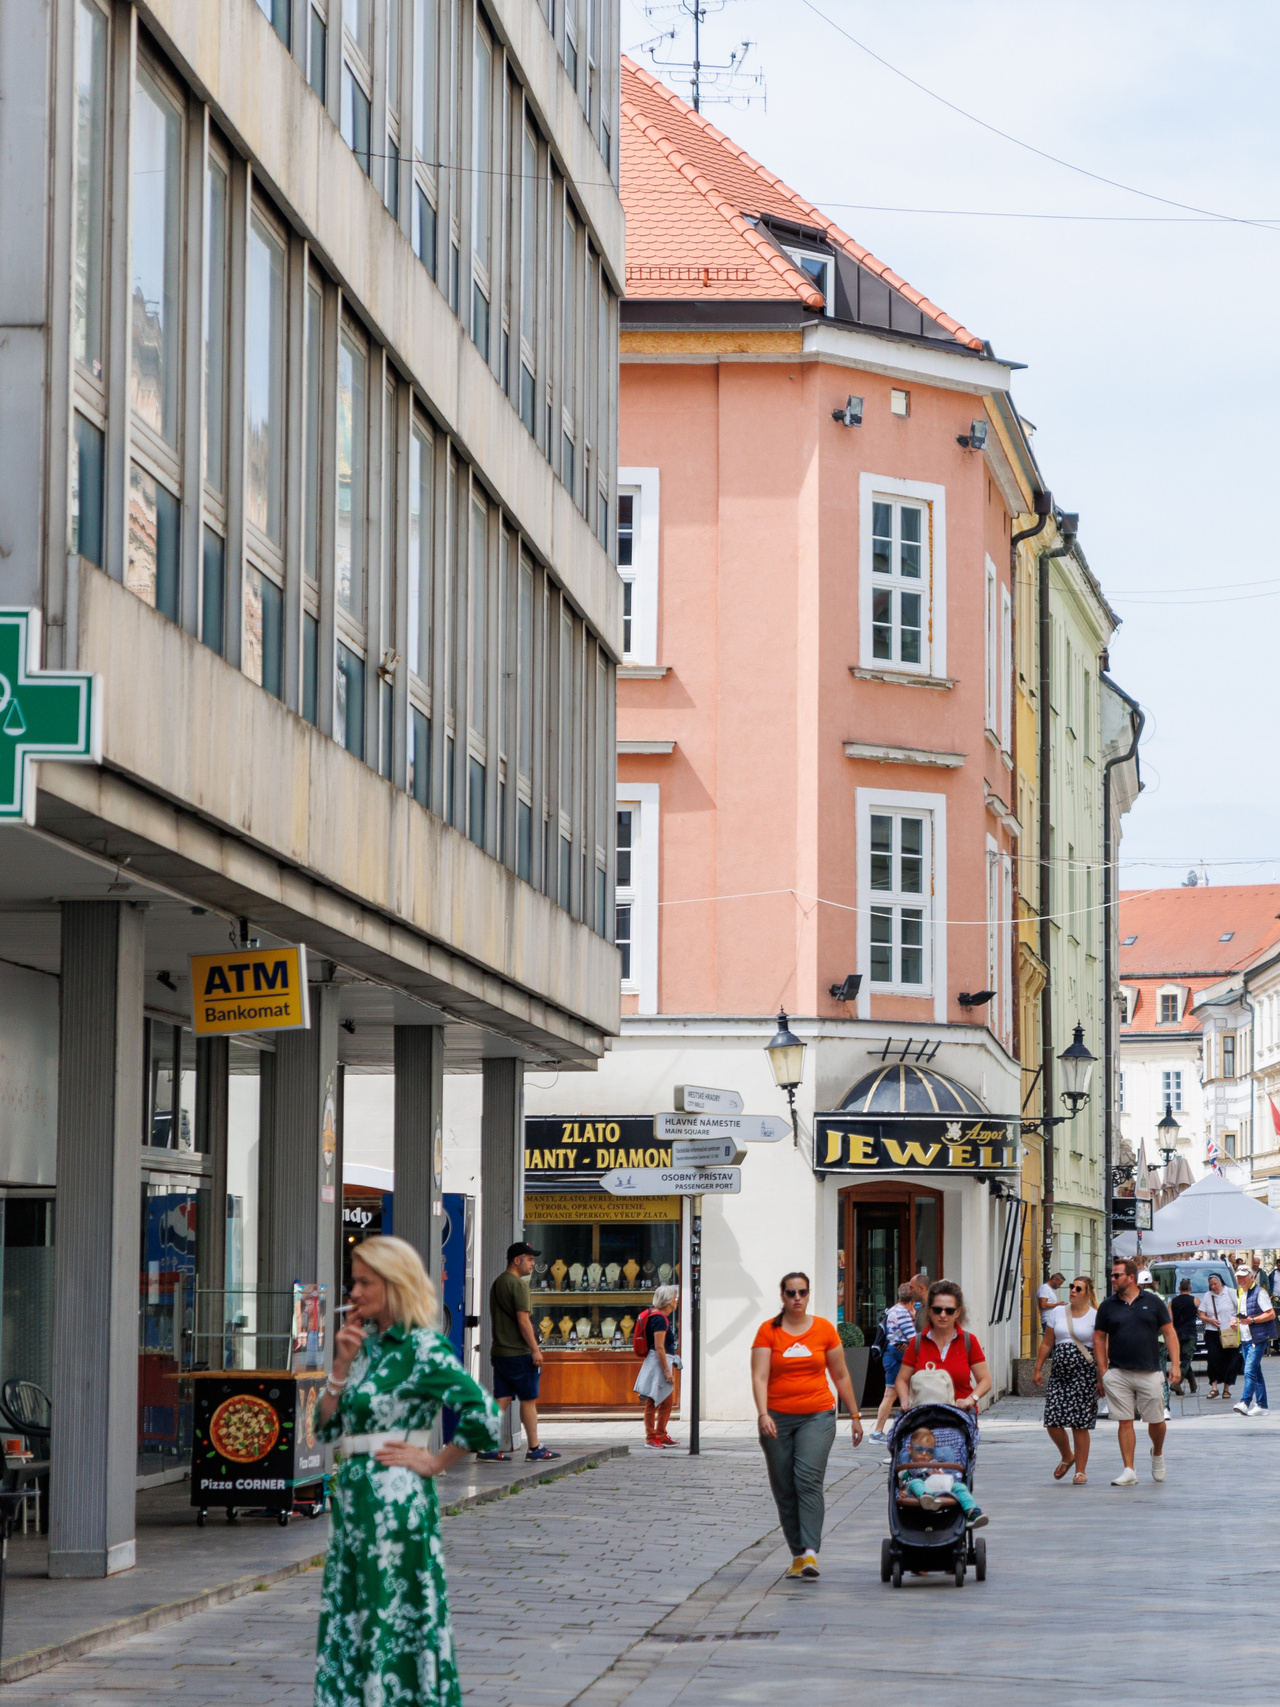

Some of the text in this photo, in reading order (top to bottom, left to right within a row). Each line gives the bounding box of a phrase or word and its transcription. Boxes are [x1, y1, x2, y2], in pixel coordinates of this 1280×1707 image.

[204, 960, 289, 995] ATM
[205, 1002, 291, 1023] Bankomat
[665, 1117, 741, 1128] HLAVNÉ NÁMESTIE
[561, 1122, 621, 1143] ZLATO
[683, 1128, 710, 1136] SQUARE
[596, 1148, 673, 1169] DIAMON
[661, 1172, 733, 1181] OSOBNÝ PRÍSTAV
[614, 1211, 641, 1219] VÝKUP
[643, 1211, 668, 1219] ZLATA
[1176, 1239, 1205, 1248] STELLA
[200, 1479, 286, 1490] Pizza CORNER
